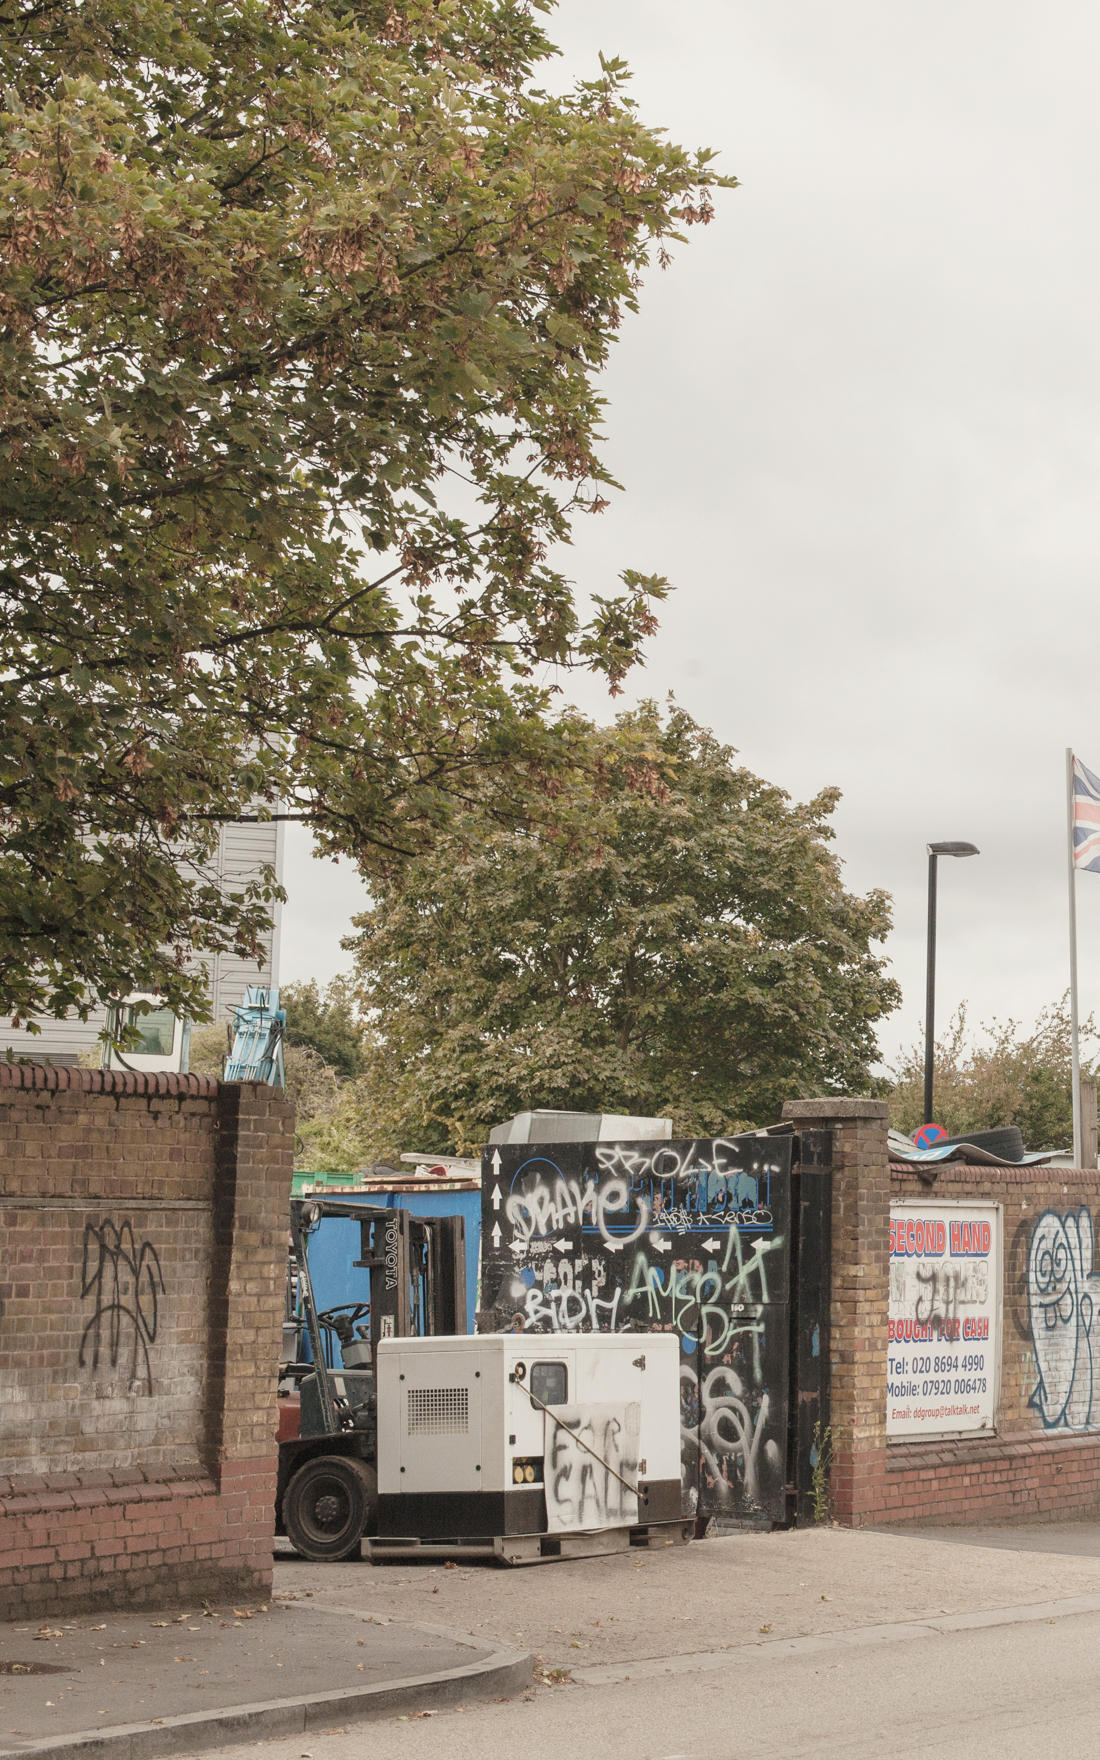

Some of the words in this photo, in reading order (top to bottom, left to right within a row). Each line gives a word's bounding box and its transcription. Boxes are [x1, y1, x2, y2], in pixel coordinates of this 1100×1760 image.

[889, 1218, 946, 1258] SECOND
[949, 1220, 992, 1258] HAND
[385, 1218, 398, 1290] TOYOTA
[888, 1317, 934, 1344] BOUGHT
[937, 1316, 961, 1342] FOR
[963, 1315, 990, 1341] CASH
[888, 1357, 909, 1375] Tel:
[912, 1356, 931, 1374] 020
[933, 1355, 959, 1373] 8694
[961, 1354, 985, 1372] 4990
[887, 1381, 920, 1397] Mobile:
[922, 1379, 952, 1396] 07920
[954, 1378, 987, 1394] 006478
[892, 1407, 912, 1419] Email:
[913, 1404, 980, 1420] ddgroup@talktalk.net
